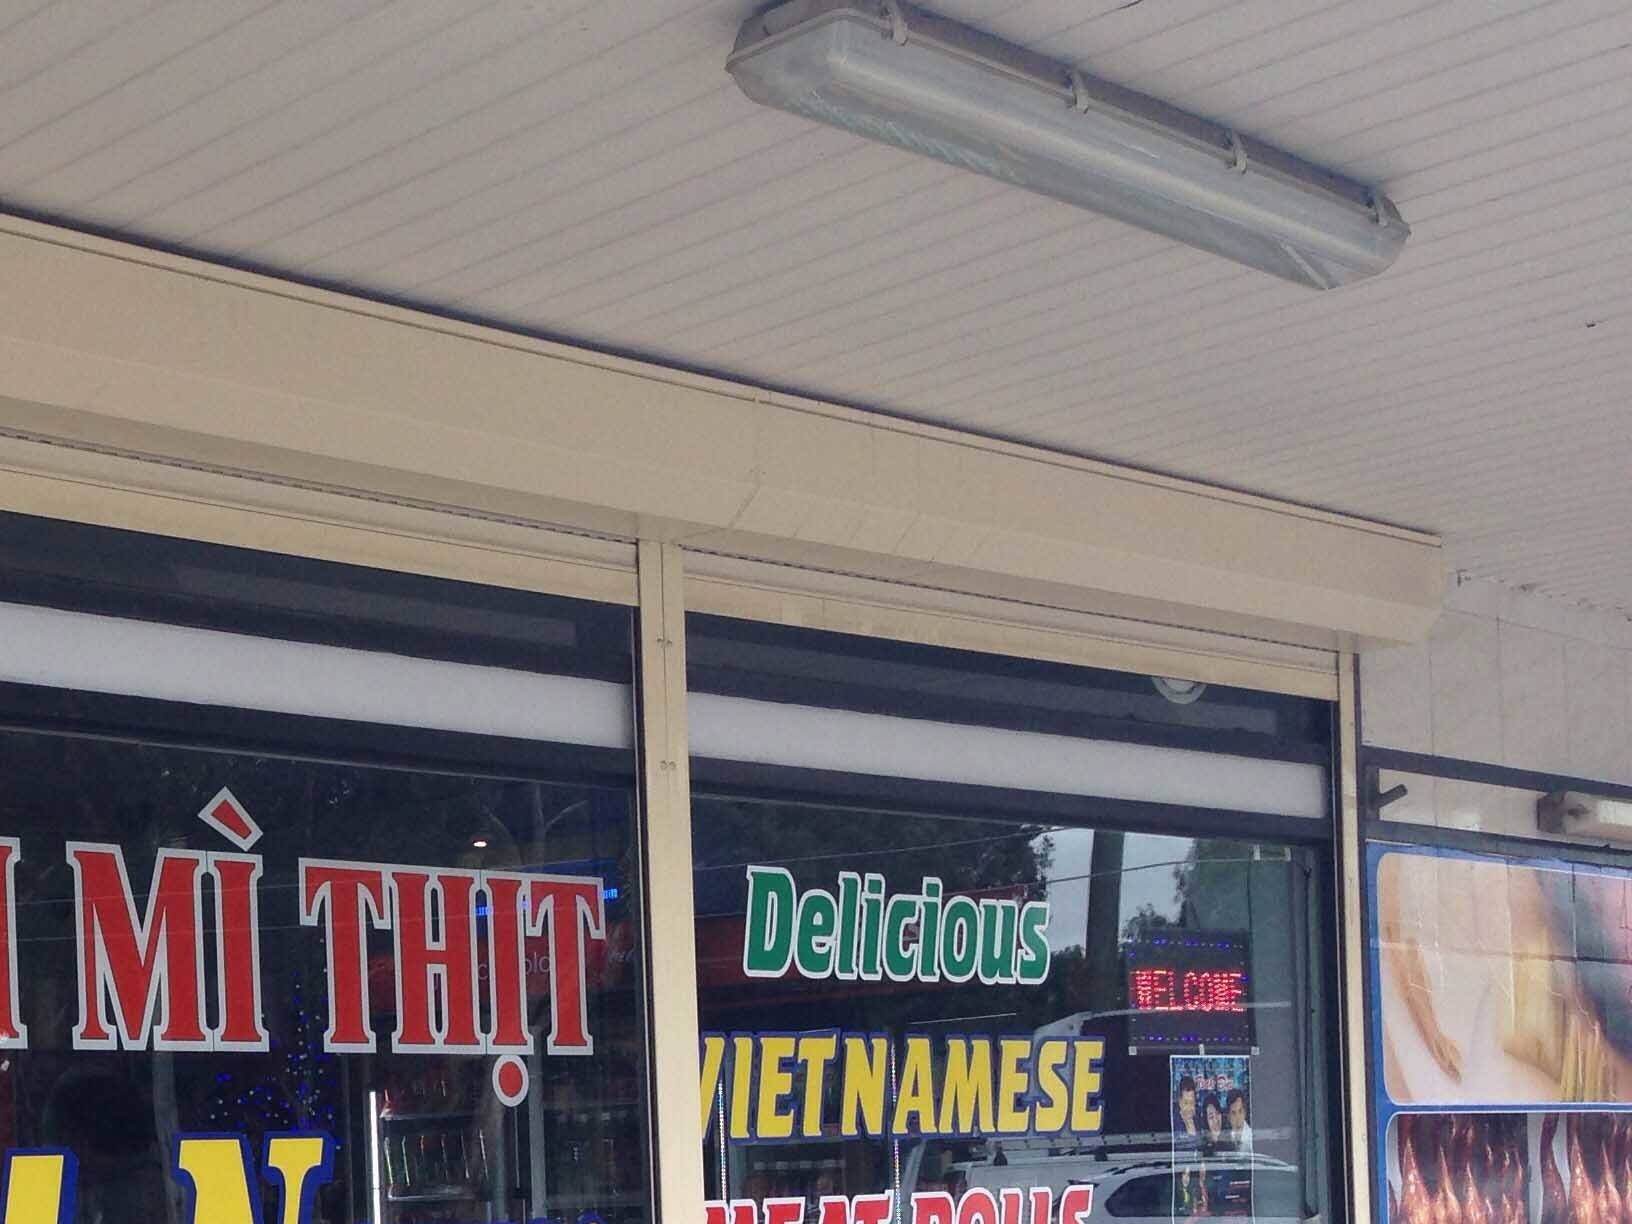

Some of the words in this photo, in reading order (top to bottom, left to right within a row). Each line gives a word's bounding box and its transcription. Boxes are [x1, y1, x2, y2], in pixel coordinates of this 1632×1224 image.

[66, 786, 270, 1053] MÌ
[298, 856, 606, 1107] THỊT
[743, 865, 1050, 985] Delicious
[700, 1027, 1109, 1145] VIETNAMESE
